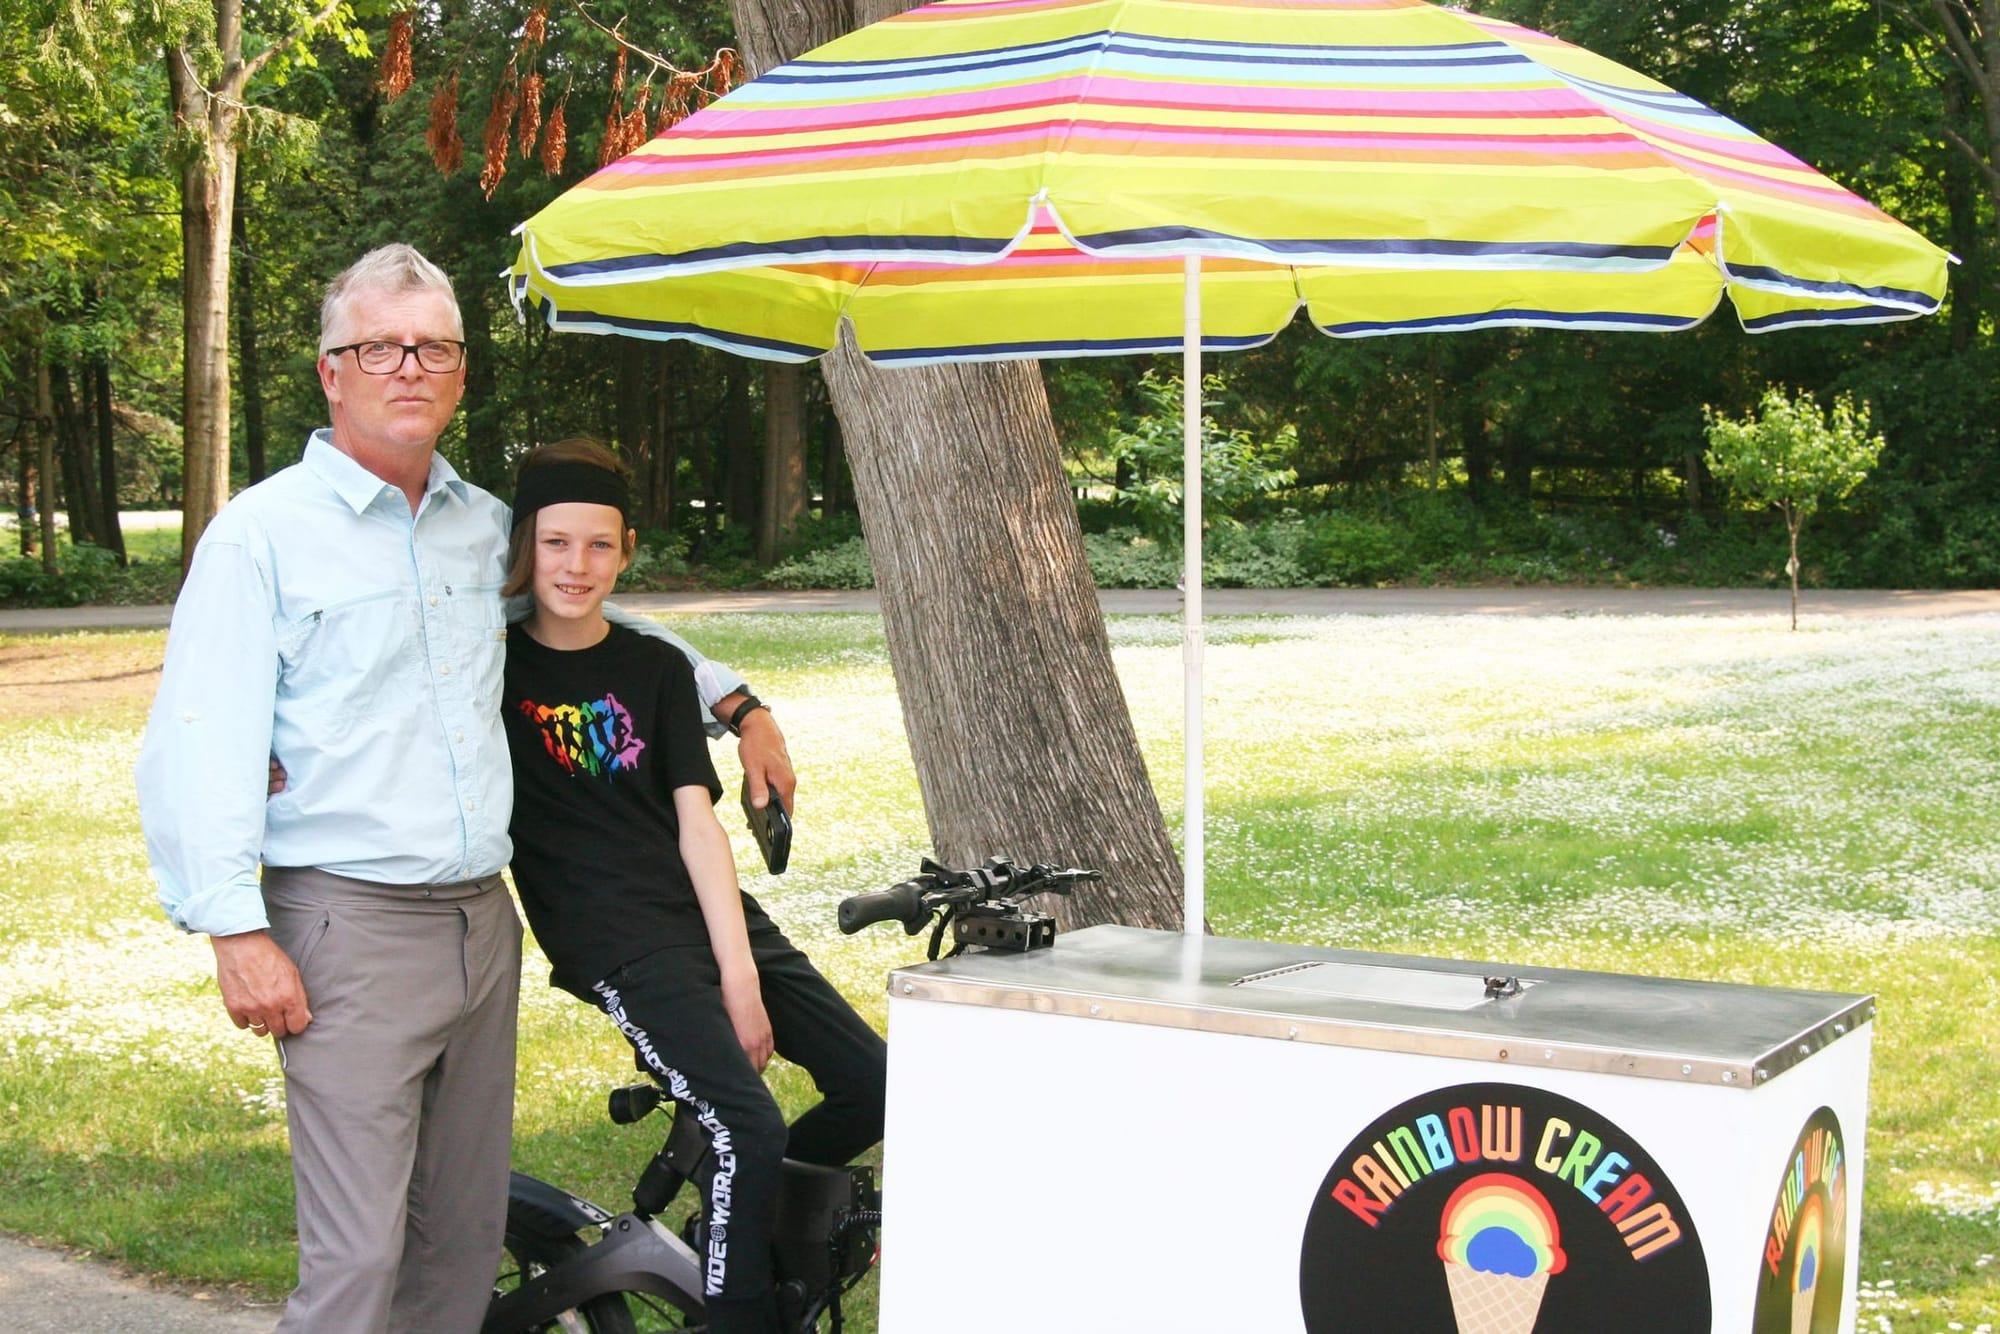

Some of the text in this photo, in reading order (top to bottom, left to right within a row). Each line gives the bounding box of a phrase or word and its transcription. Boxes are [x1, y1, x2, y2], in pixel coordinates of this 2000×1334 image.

[1331, 1104, 1682, 1262] RAINBOW CREAM
[1765, 1127, 1823, 1277] RAINBOW
